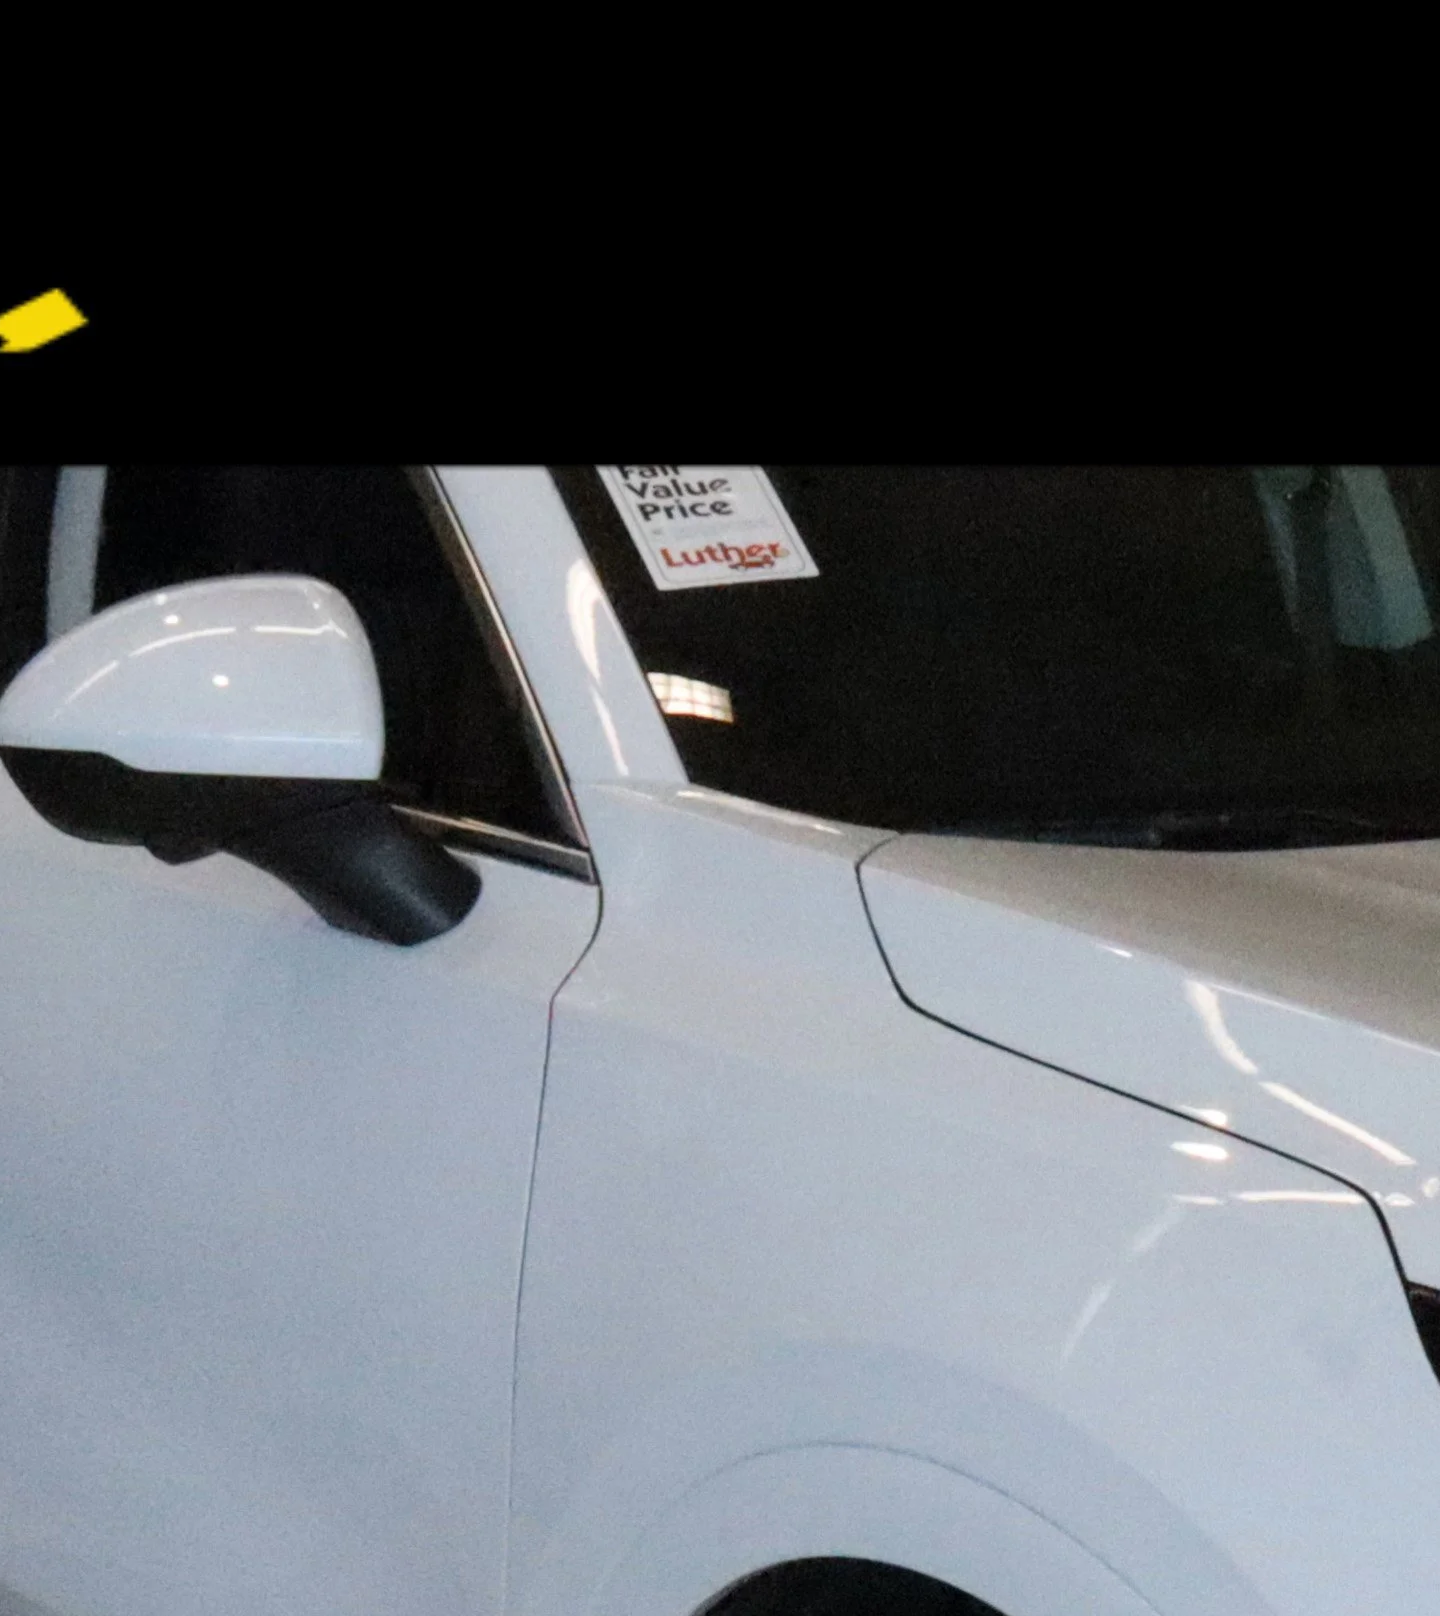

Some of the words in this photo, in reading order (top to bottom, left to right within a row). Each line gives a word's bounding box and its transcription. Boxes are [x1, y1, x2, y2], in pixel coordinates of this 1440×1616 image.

[625, 478, 731, 498] Value
[637, 499, 733, 521] Price
[660, 542, 781, 568] Luther
